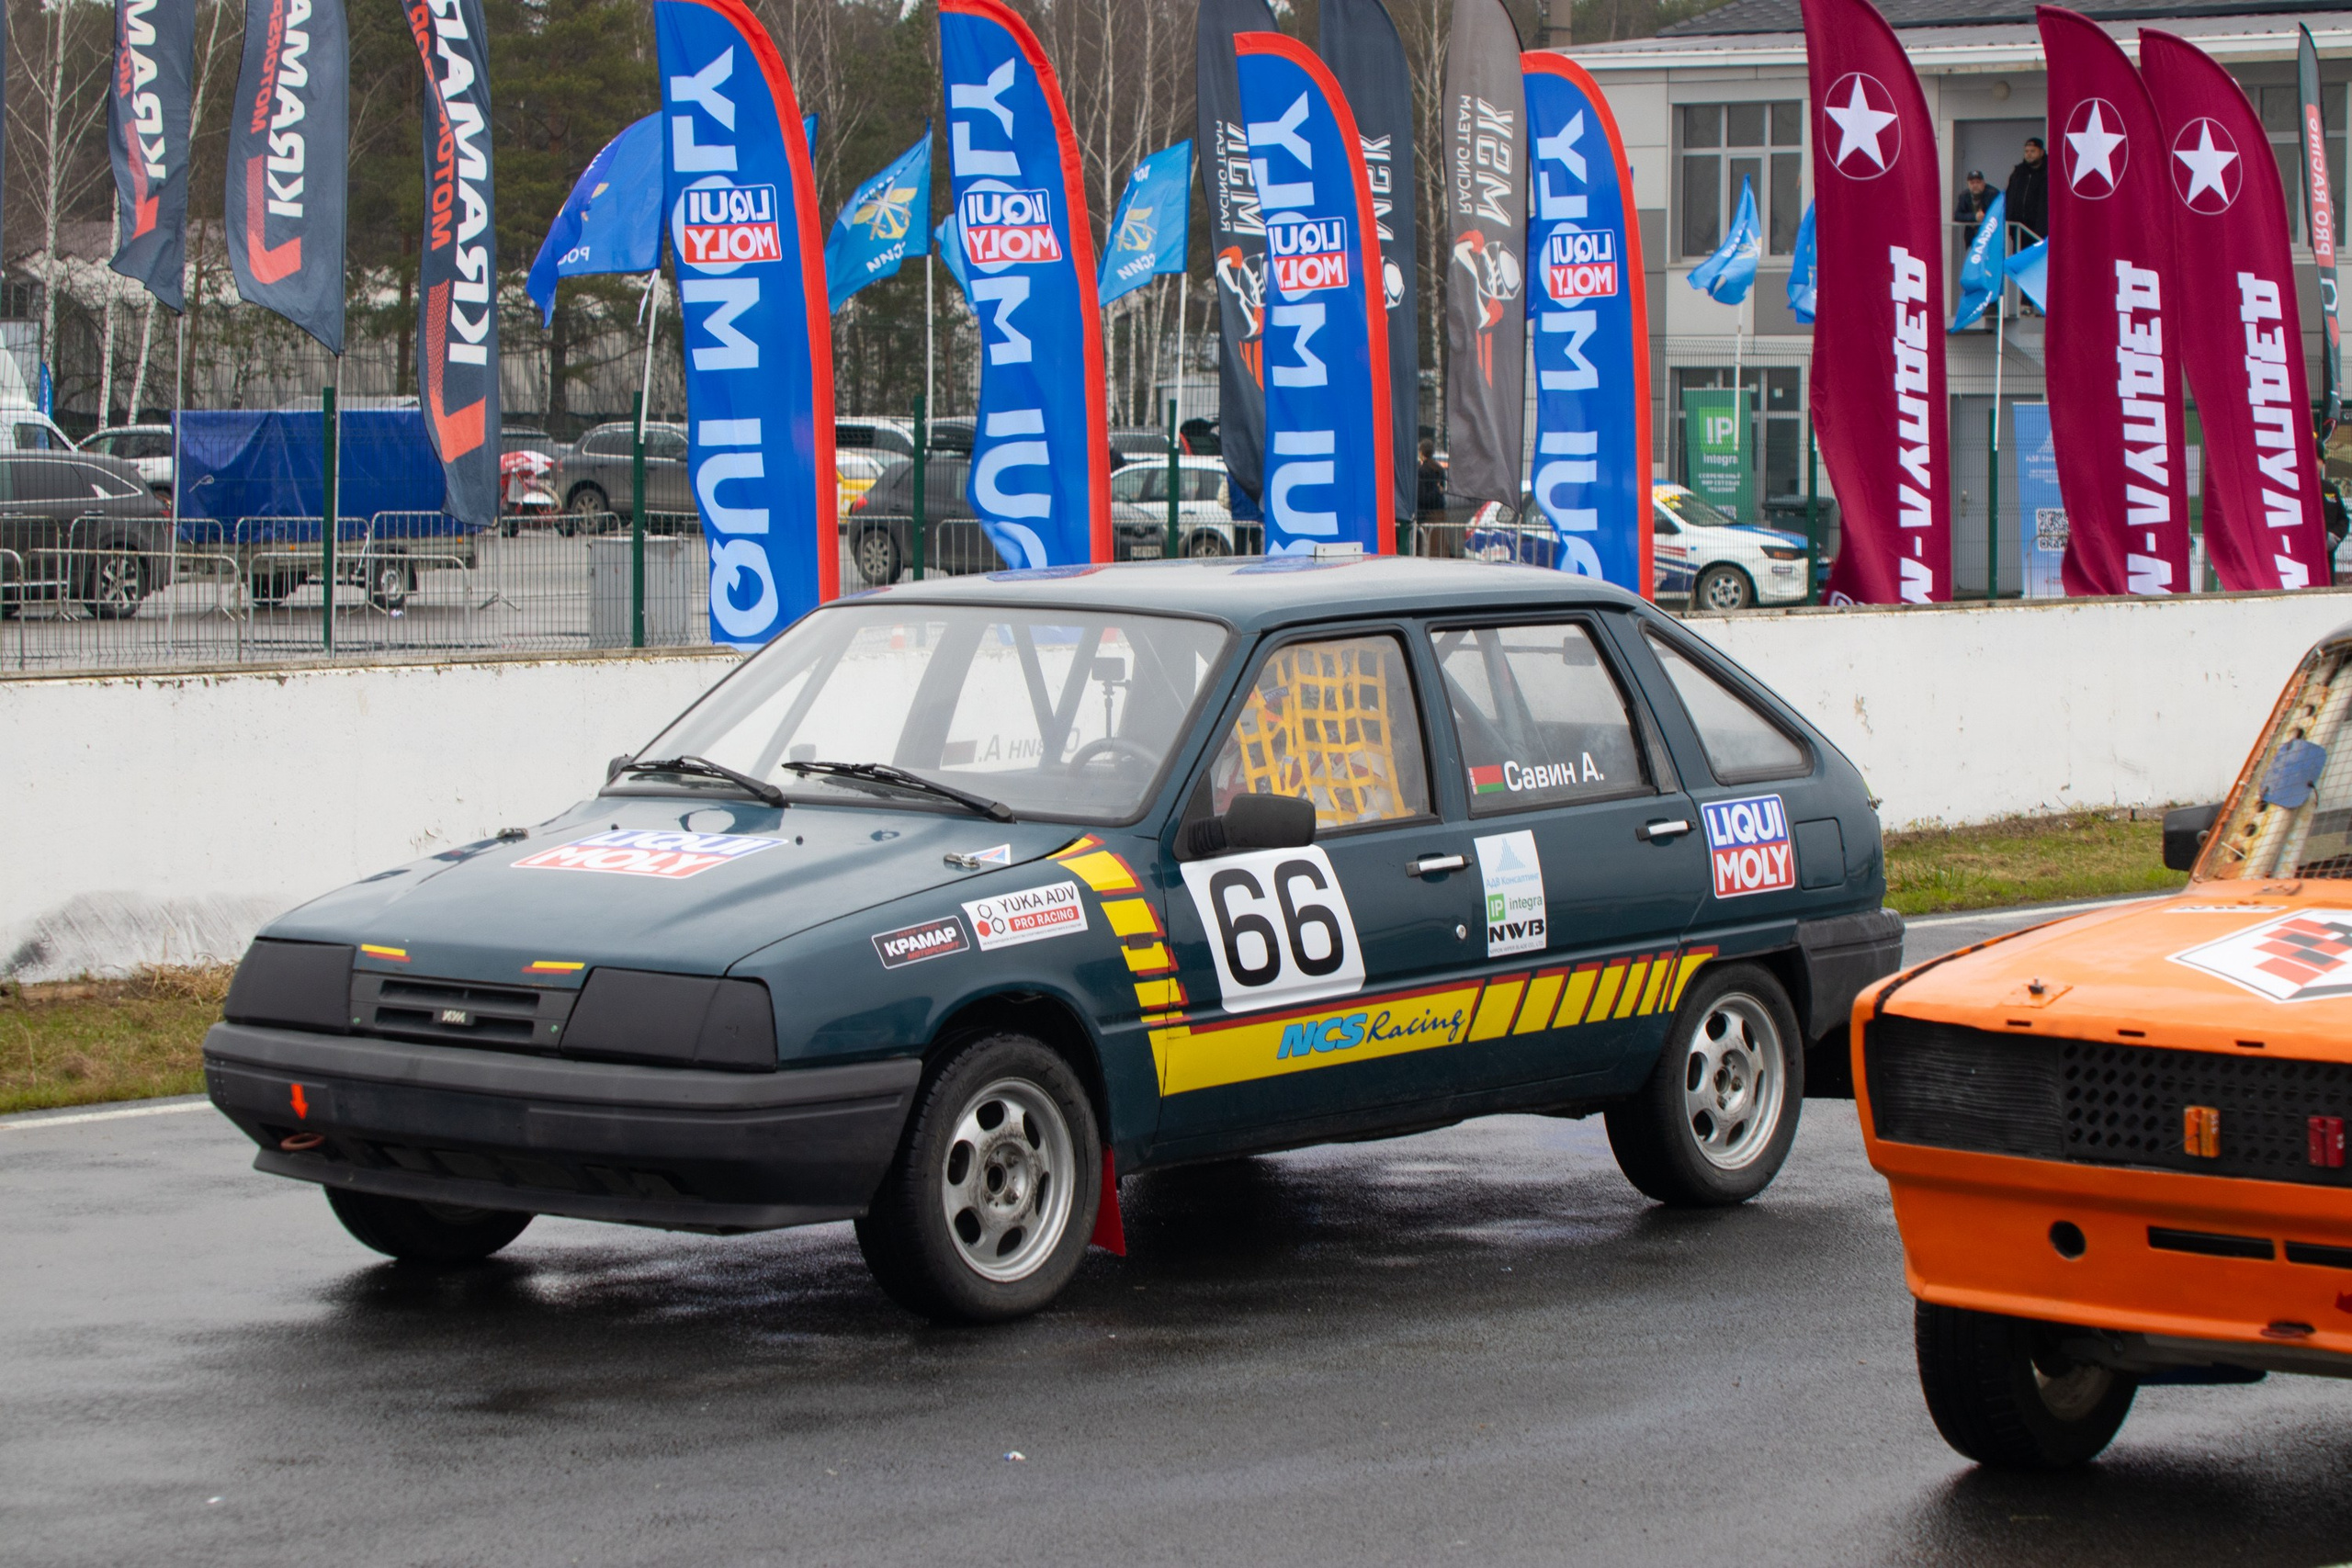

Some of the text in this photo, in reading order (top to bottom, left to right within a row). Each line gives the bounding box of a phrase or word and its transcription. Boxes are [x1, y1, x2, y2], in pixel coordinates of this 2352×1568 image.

[1706, 416, 1733, 445] IP
[1703, 454, 1738, 466] integra
[1504, 751, 1605, 792] Савин А.
[1707, 800, 1784, 846] LIQUI
[579, 830, 773, 855] LIQUI
[526, 846, 726, 874] MOLY
[1716, 844, 1789, 892] MOLY
[1486, 872, 1541, 888] АДВ Консалтинг
[998, 886, 1076, 913] YUKA ADV
[1490, 895, 1544, 918] IP integra
[1013, 908, 1074, 930] PRO RACING
[1209, 859, 1344, 987] 66
[1488, 919, 1545, 942] NWB
[1276, 1009, 1465, 1060] NCS Racing
